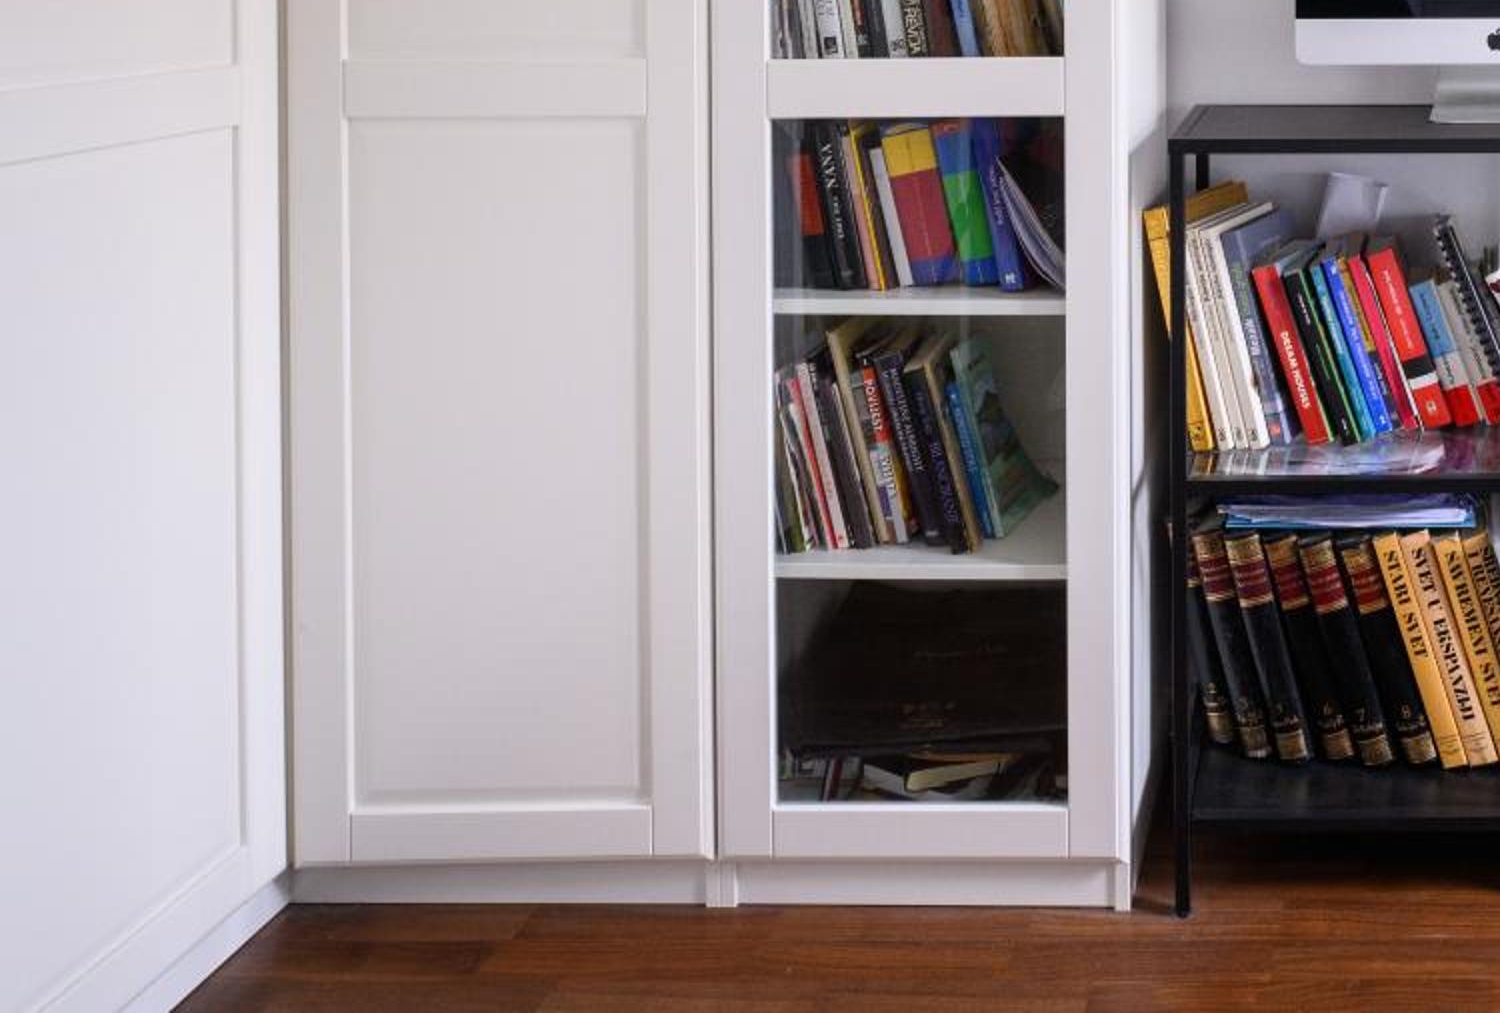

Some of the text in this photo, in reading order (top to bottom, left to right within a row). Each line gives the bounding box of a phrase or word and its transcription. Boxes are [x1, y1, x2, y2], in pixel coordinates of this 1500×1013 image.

[865, 378, 883, 431] POVIJEST
[1280, 330, 1311, 409] DREAM HOUSES
[1384, 549, 1429, 658] STARI SVET
[1411, 546, 1476, 722] SVET U EKSPANZIJI
[1445, 550, 1487, 657] SAVREMENI
